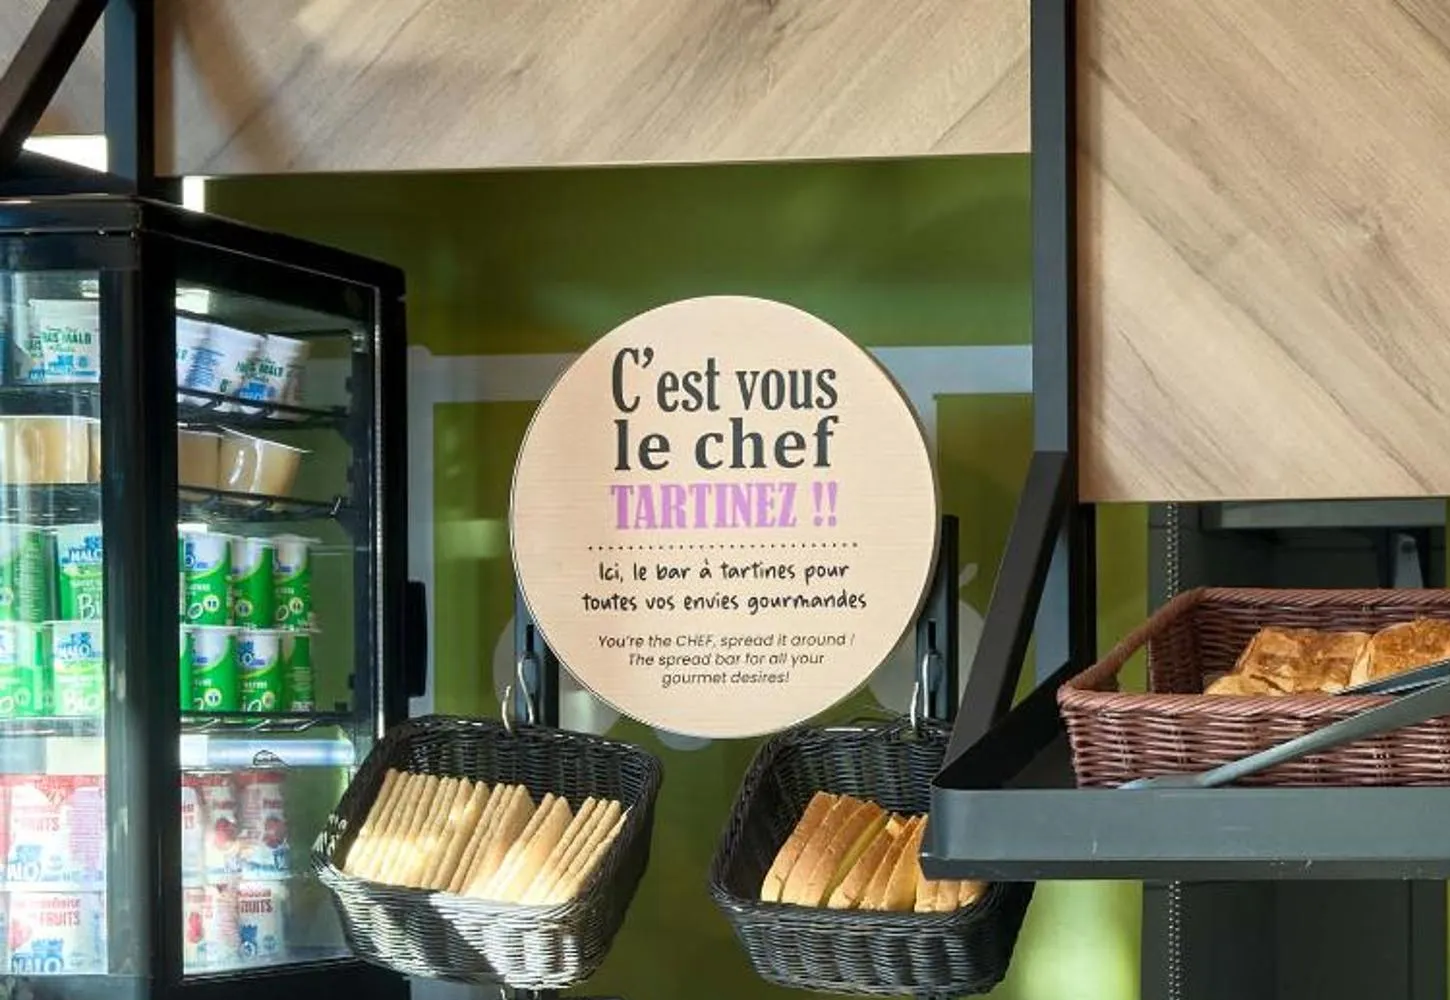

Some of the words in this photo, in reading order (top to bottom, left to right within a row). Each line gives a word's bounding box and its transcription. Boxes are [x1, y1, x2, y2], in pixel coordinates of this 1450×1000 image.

[612, 347, 721, 413] C'est
[735, 368, 838, 411] vous
[614, 418, 671, 471] le
[694, 415, 840, 470] chef
[610, 482, 797, 530] TARTINEZ
[811, 480, 838, 527] !!
[599, 561, 623, 583] Ici,
[633, 562, 647, 581] le
[656, 563, 691, 581] bar
[699, 558, 712, 579] à
[720, 561, 795, 580] tartines
[803, 564, 849, 585] pour
[582, 592, 637, 612] toutes
[645, 595, 675, 610] vos
[683, 591, 739, 610] envies
[747, 589, 867, 616] gourmandes
[598, 634, 644, 649] You're
[647, 635, 672, 648] the
[720, 633, 774, 650] spread
[776, 633, 787, 647] it
[790, 633, 846, 647] around
[628, 653, 655, 667] The
[658, 651, 712, 669] spread
[714, 653, 742, 667] bar
[745, 652, 766, 666] for
[769, 652, 788, 665] all
[791, 654, 825, 669] your
[661, 672, 727, 689] gourmet
[730, 671, 790, 686] desires!
